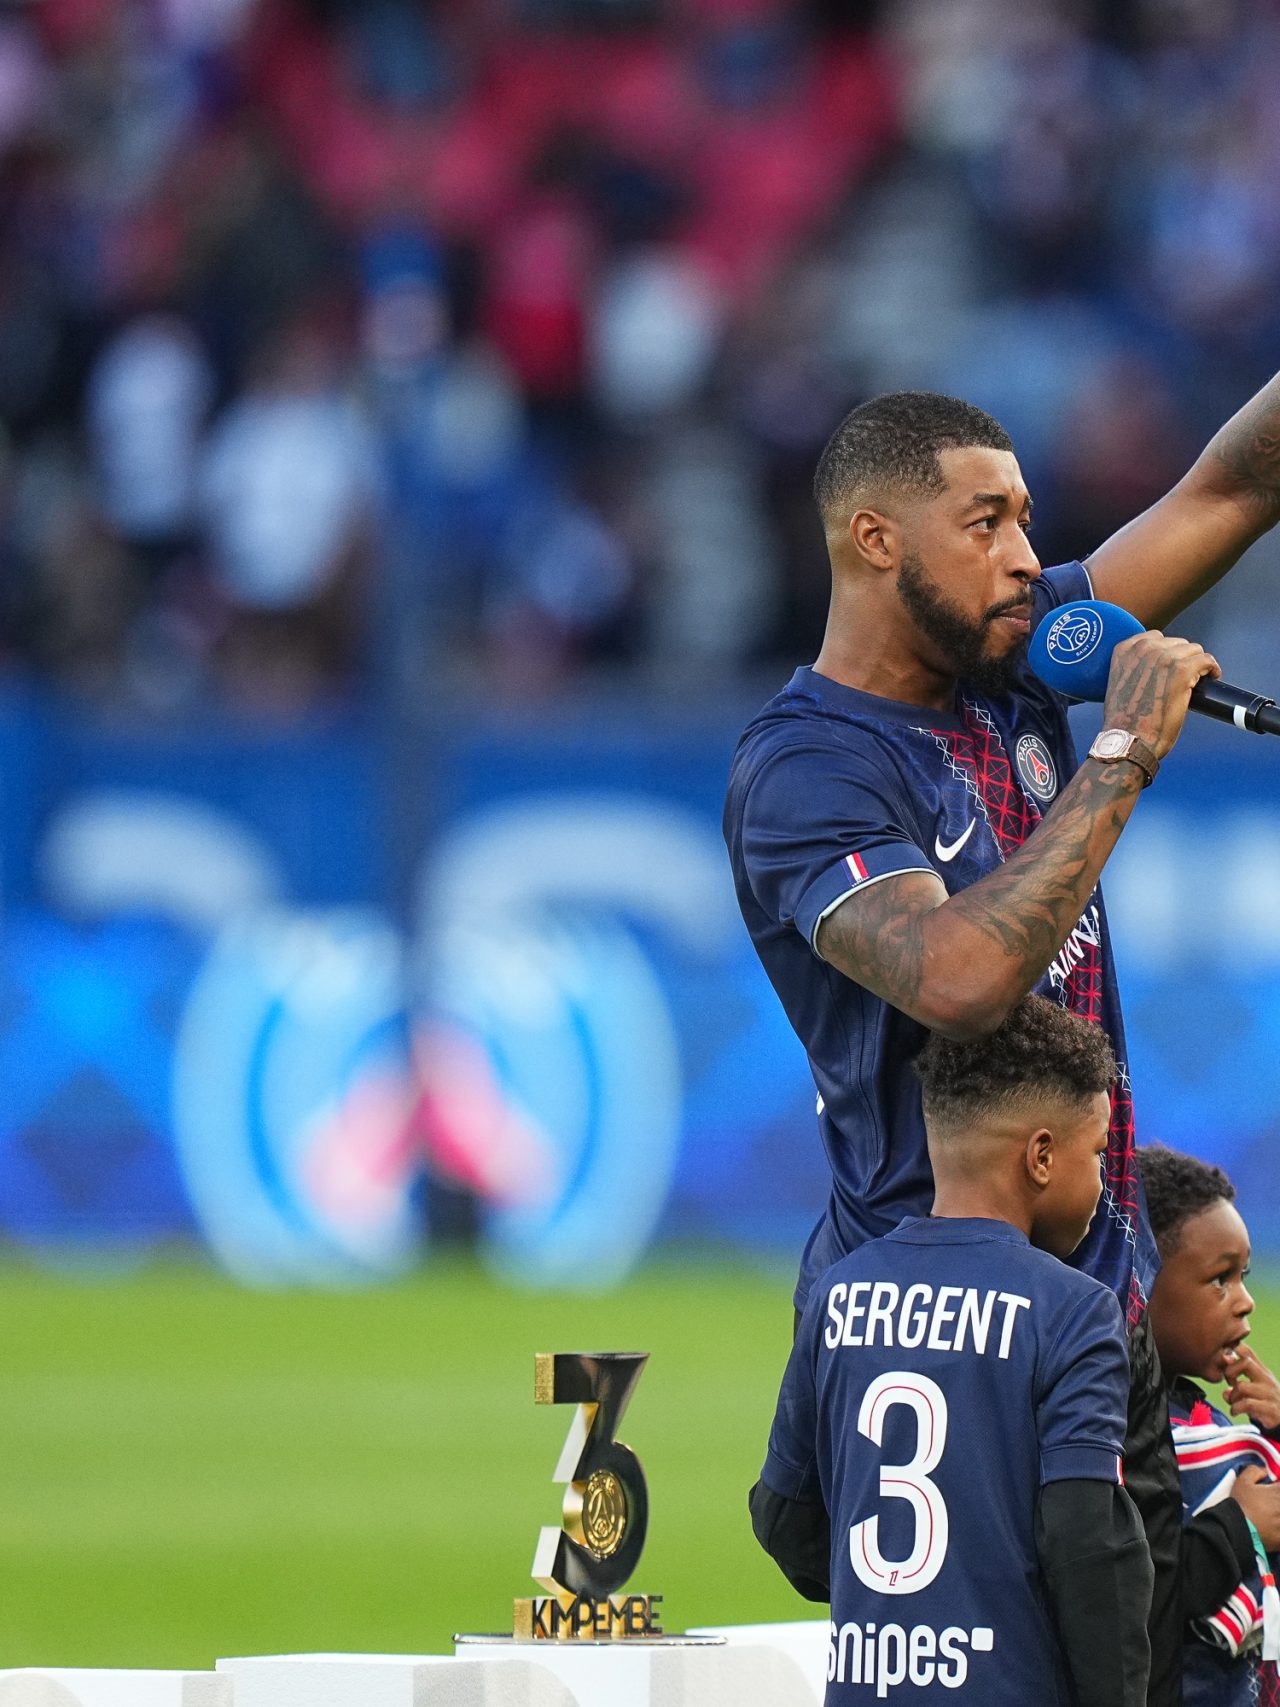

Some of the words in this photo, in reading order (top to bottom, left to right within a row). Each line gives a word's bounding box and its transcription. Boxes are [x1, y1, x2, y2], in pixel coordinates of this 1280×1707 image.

[1049, 614, 1071, 650] PARIS
[1018, 738, 1038, 762] PARIS
[824, 1281, 1031, 1360] SERGENT
[849, 1371, 949, 1594] 3
[531, 1595, 664, 1639] KIMPEMBE
